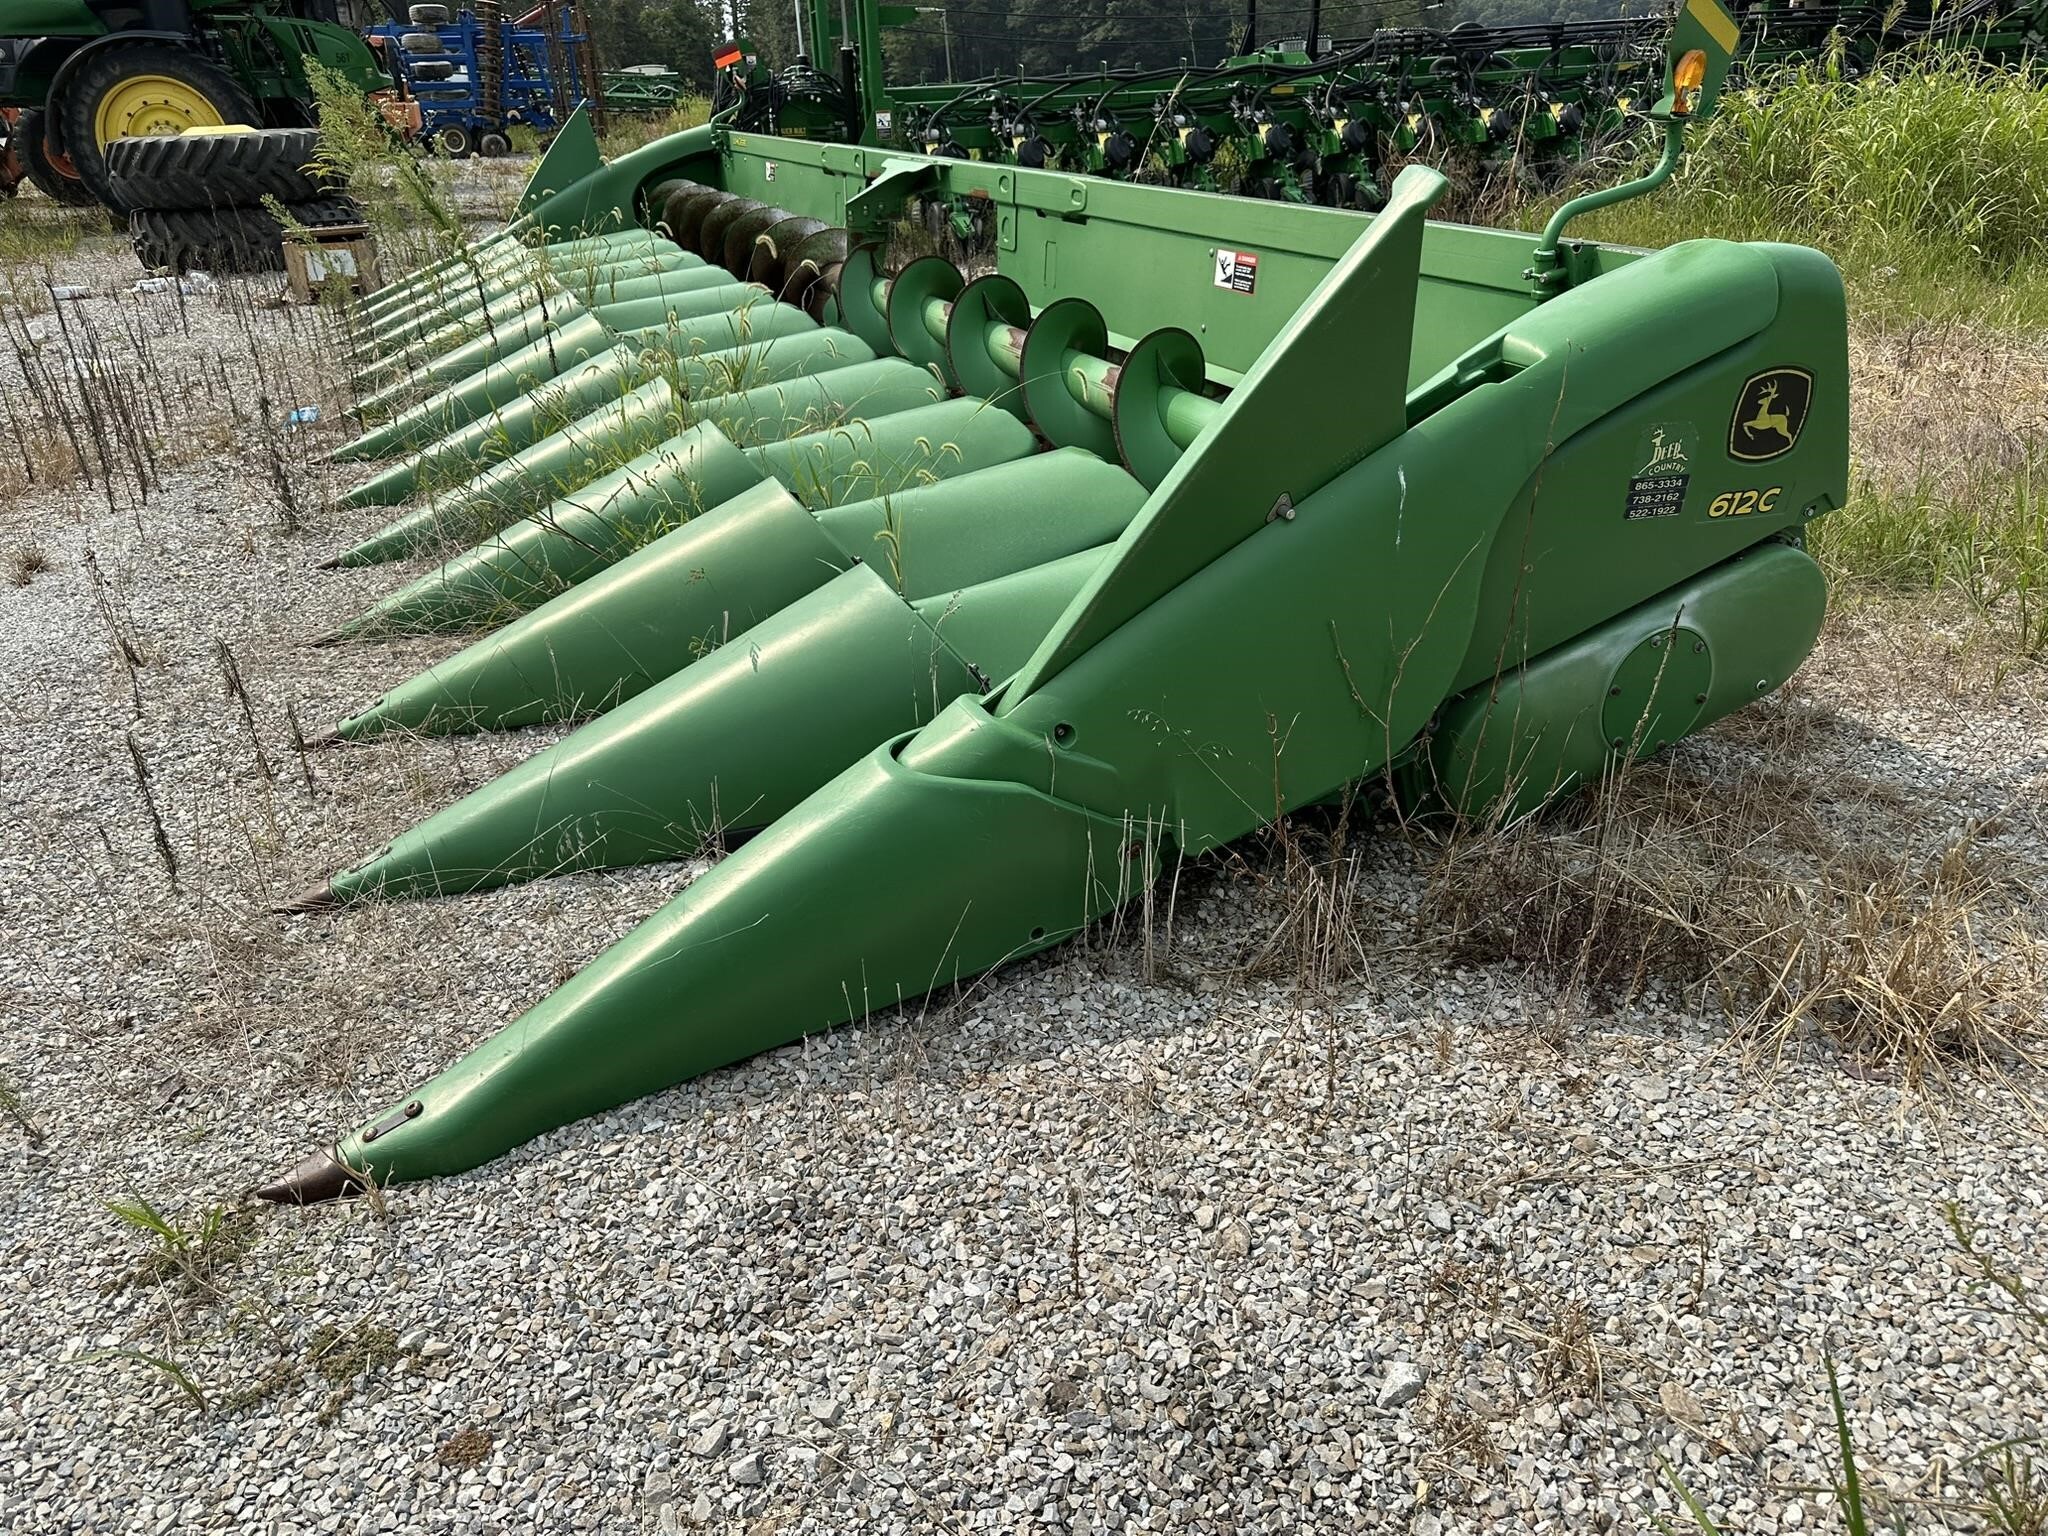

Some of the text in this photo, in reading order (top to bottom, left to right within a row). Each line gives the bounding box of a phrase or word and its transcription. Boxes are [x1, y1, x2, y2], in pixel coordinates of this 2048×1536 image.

[1648, 462, 1685, 476] COUNTRY
[1635, 479, 1682, 491] 865-3334
[1633, 493, 1679, 505] 738-2162
[1708, 487, 1782, 518] 612C
[1629, 506, 1676, 518] 522-1922
